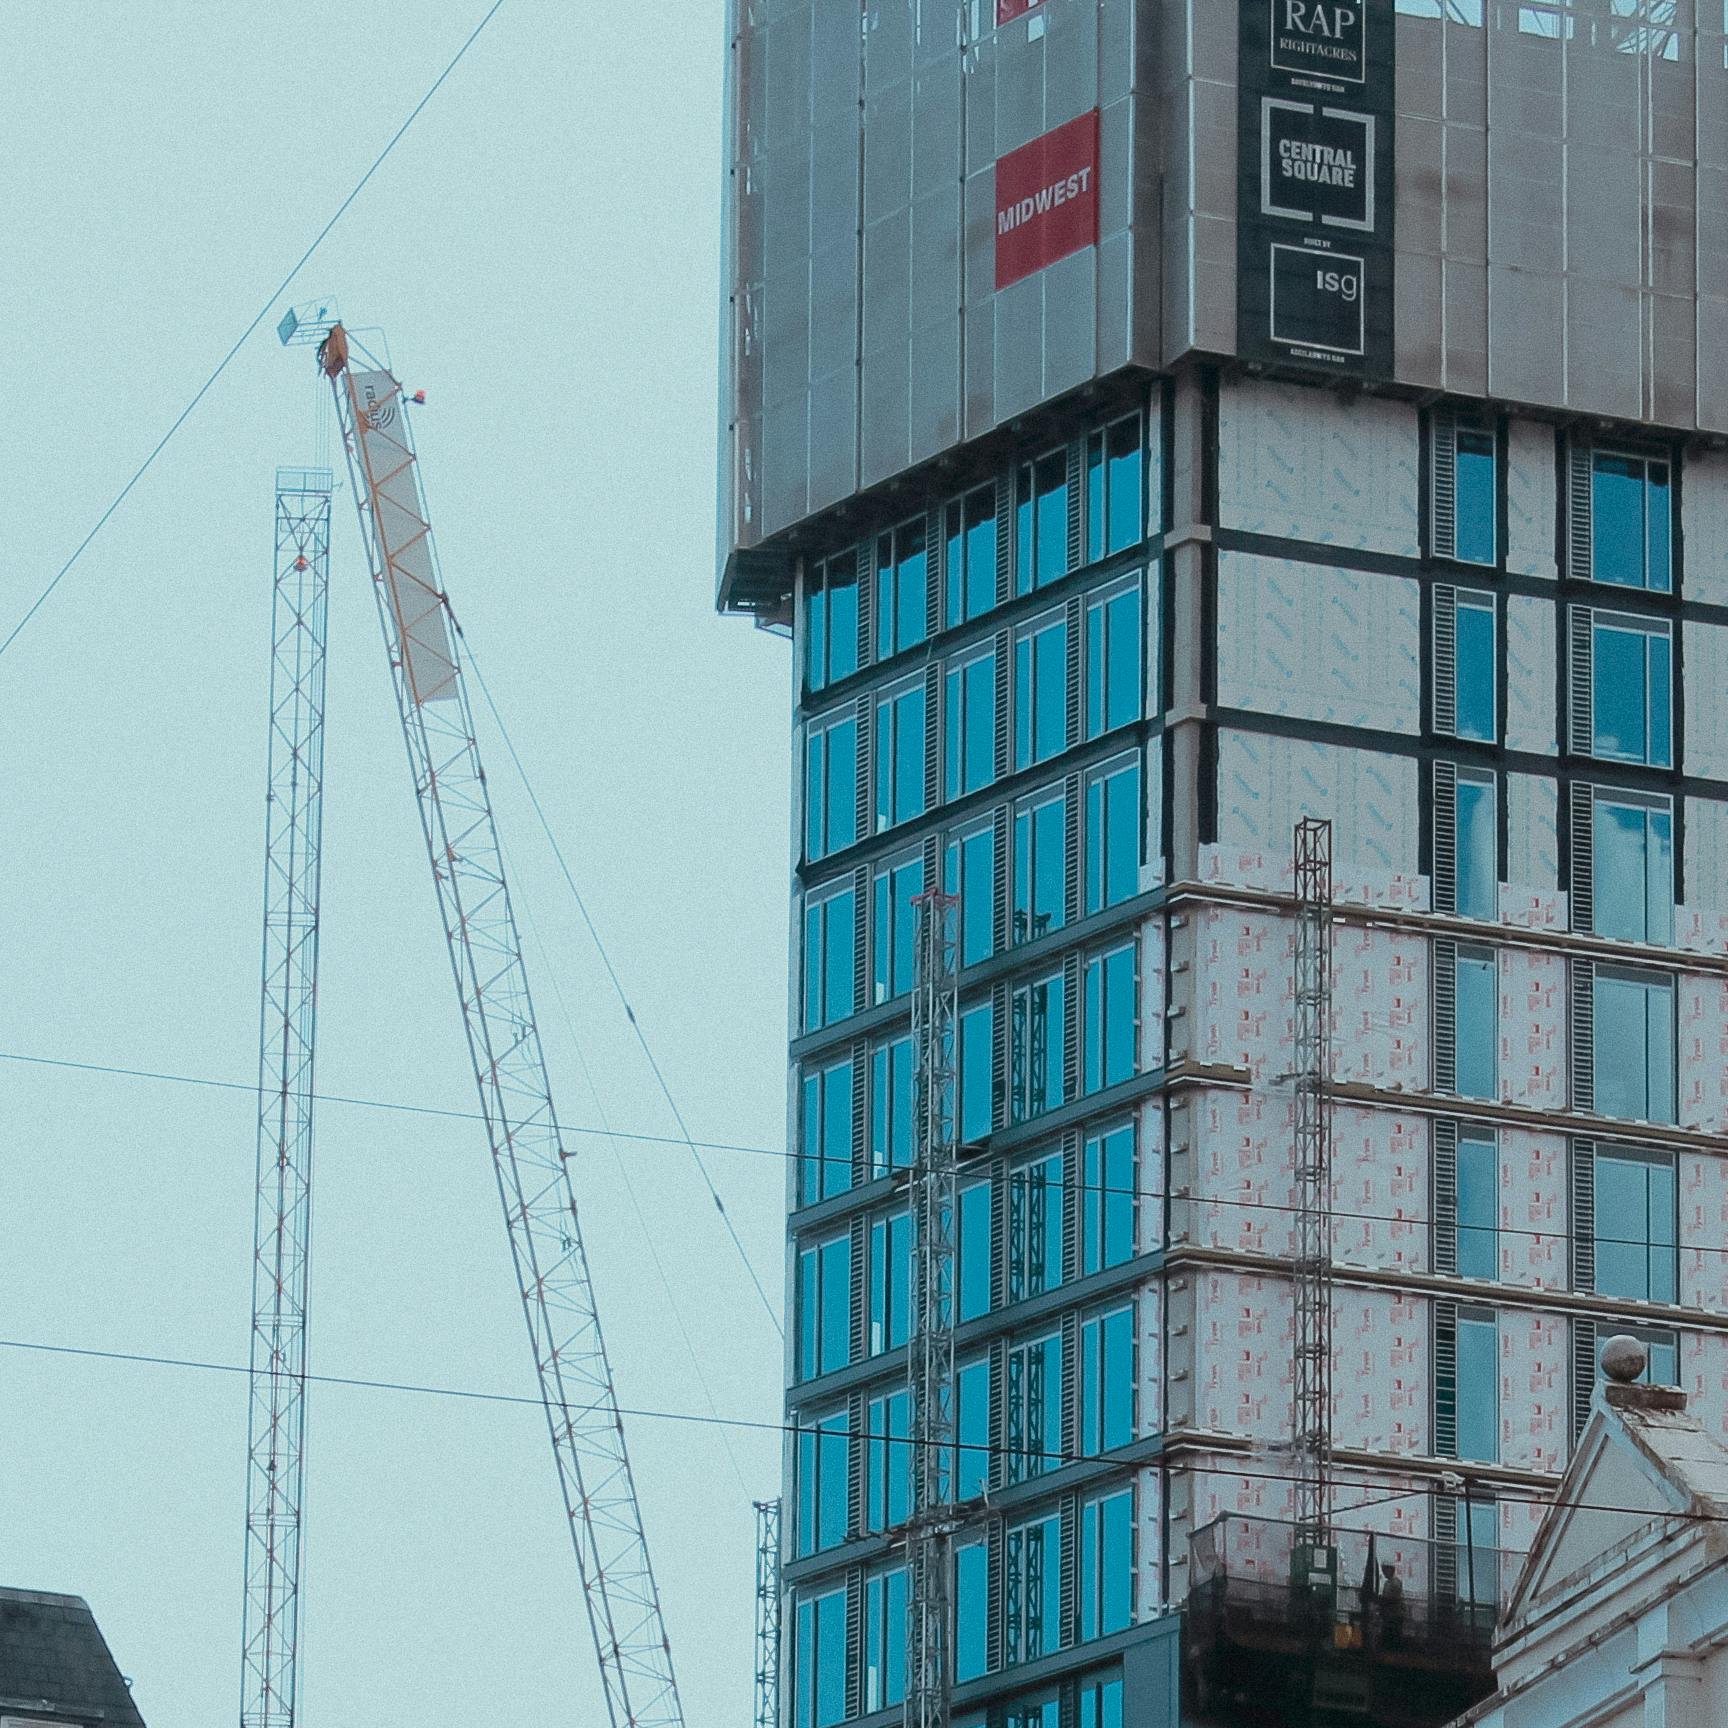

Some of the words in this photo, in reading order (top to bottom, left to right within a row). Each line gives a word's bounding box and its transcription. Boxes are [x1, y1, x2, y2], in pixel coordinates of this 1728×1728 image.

[1285, 0, 1355, 39] RAP
[1279, 37, 1357, 61] RIGHTACRES
[1279, 139, 1356, 169] CENTRAL
[1282, 158, 1355, 188] SQUARE
[997, 167, 1091, 235] MIDWEST
